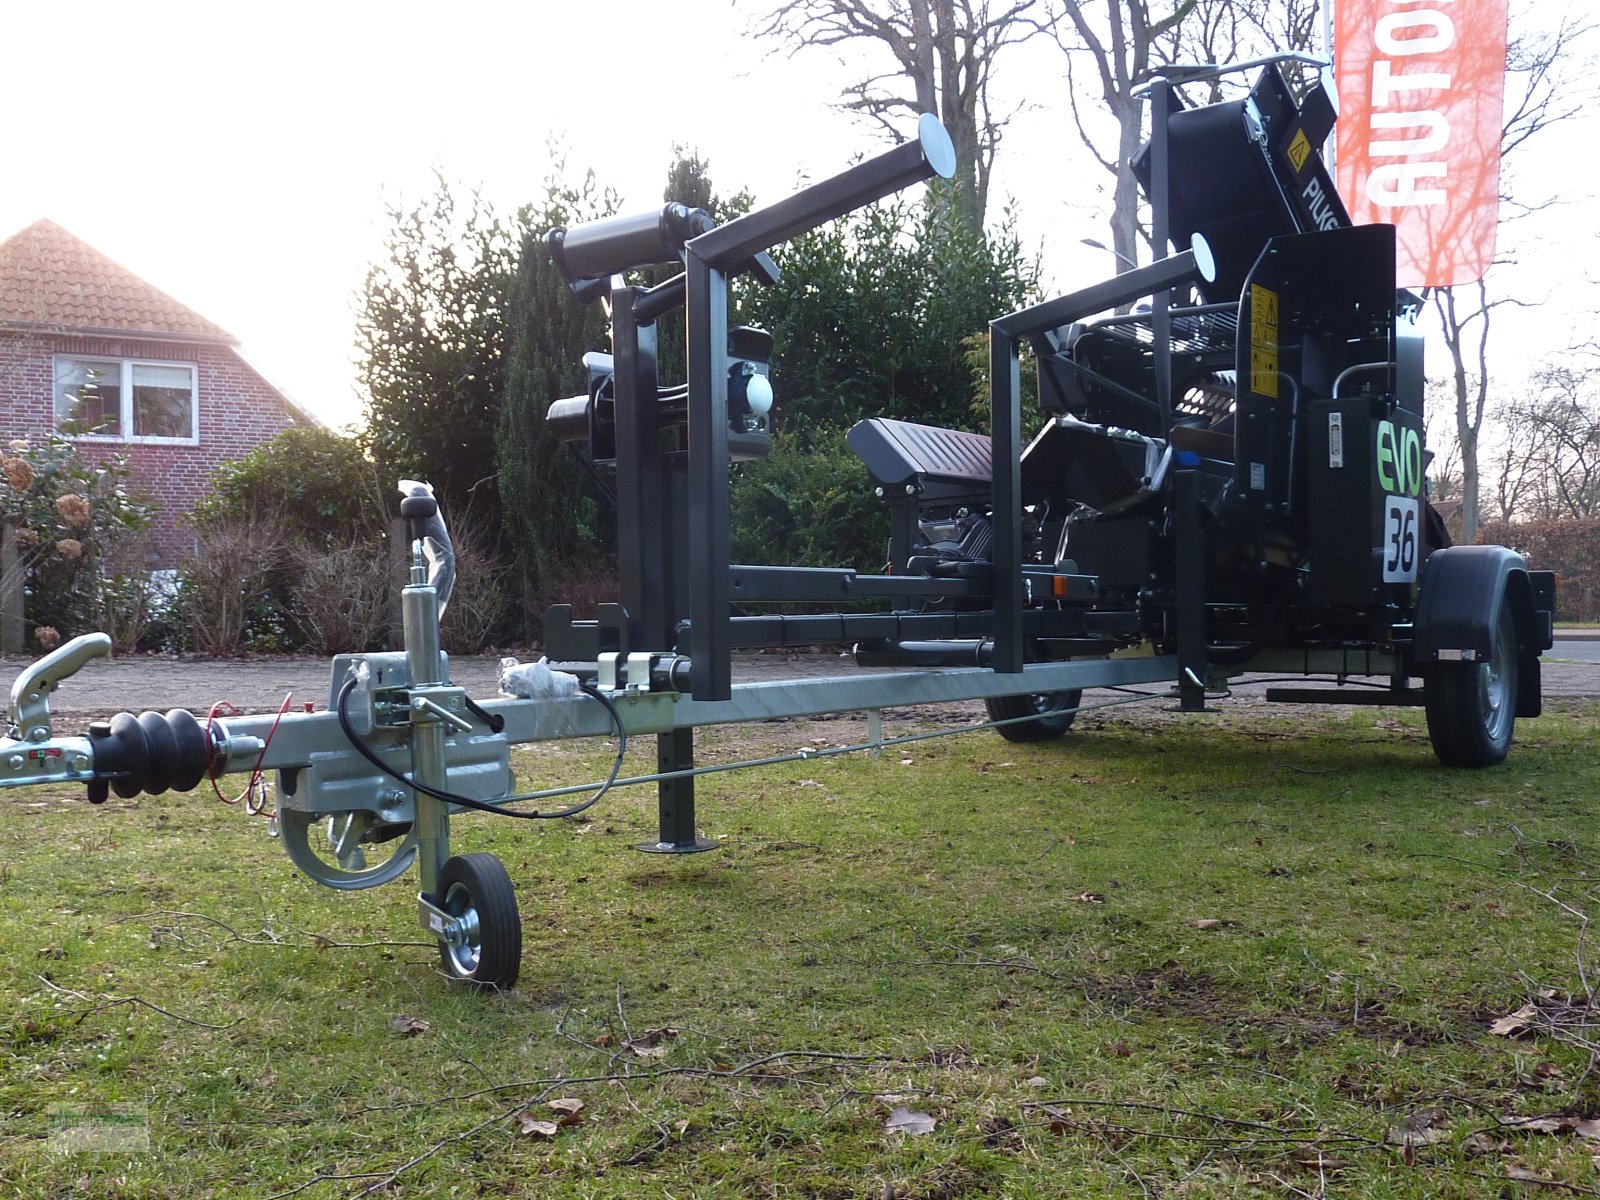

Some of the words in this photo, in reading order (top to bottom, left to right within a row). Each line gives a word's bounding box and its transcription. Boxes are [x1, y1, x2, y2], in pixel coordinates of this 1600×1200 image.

[1366, 0, 1455, 207] AUTO
[1377, 420, 1422, 496] EVO
[1387, 507, 1415, 573] 36
